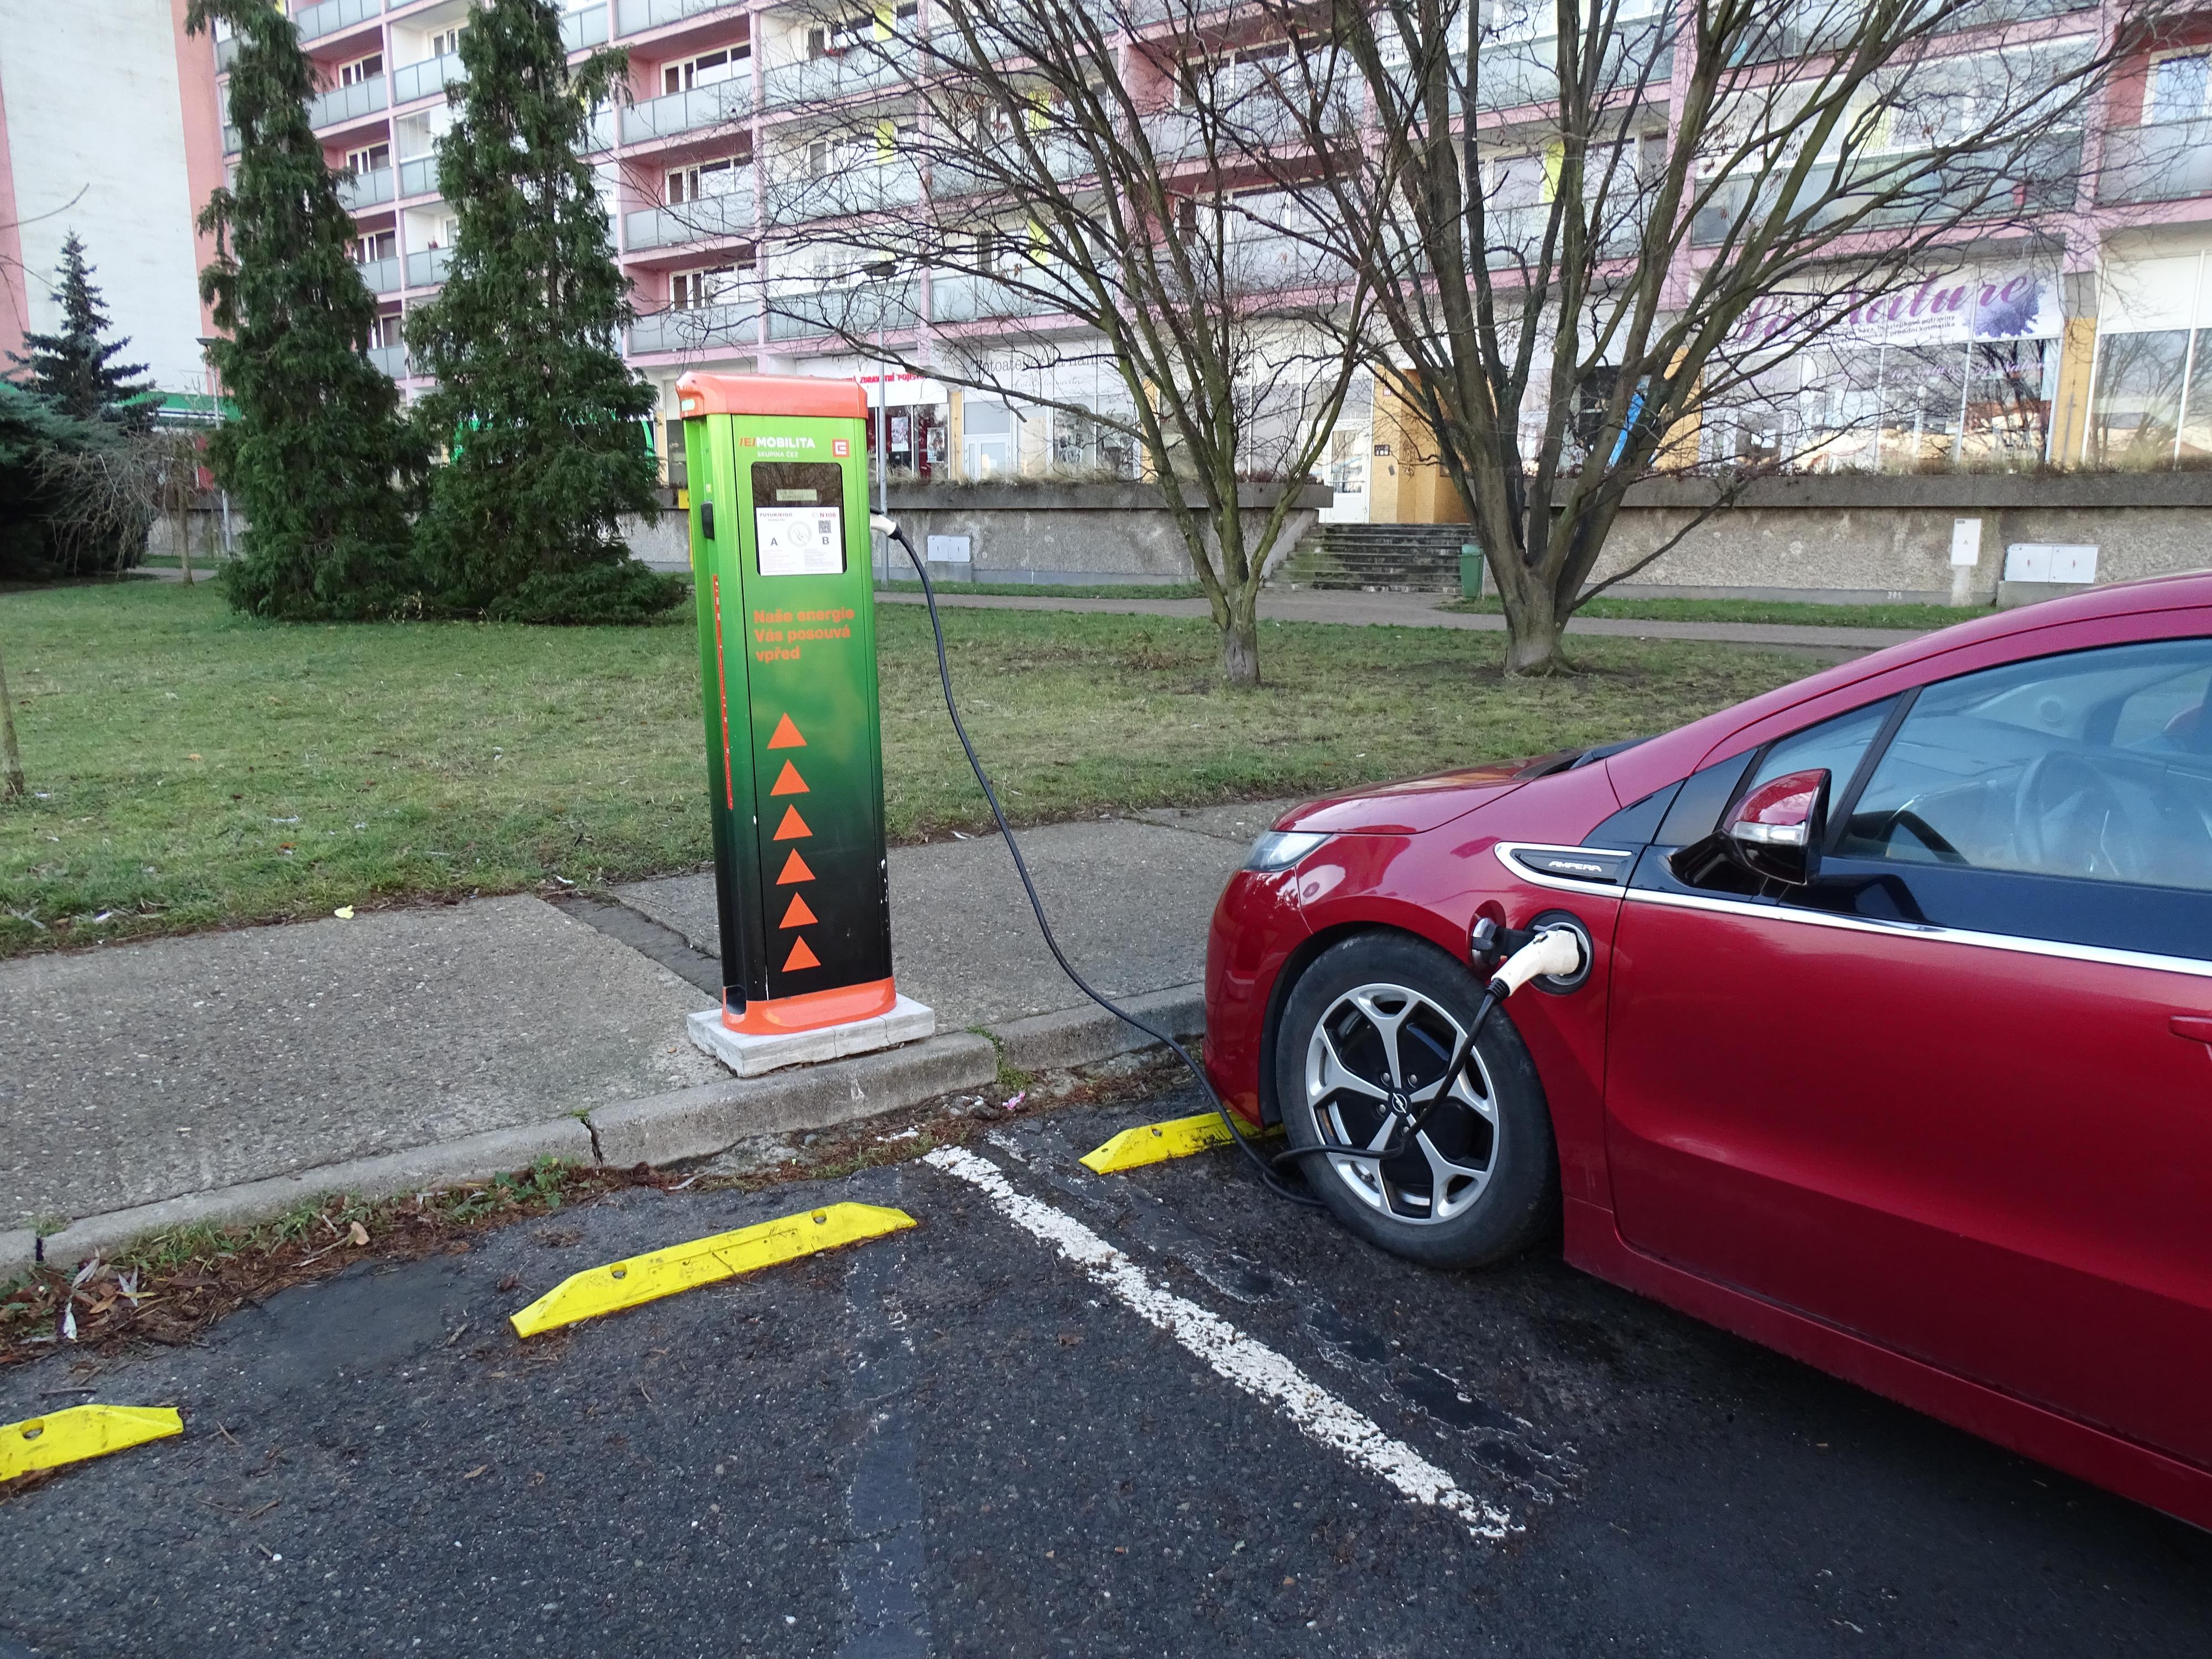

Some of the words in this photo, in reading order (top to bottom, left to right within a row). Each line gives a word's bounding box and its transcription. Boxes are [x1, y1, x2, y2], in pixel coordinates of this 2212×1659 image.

[1918, 322, 1955, 332] kosmetika
[859, 372, 895, 384] ZDRAVTNÍ
[786, 450, 799, 458] ČEZ
[770, 538, 778, 546] A
[822, 536, 830, 545] B
[753, 608, 793, 623] Naše
[796, 606, 855, 623] energie
[754, 628, 784, 643] Vás
[787, 624, 851, 644] posouvá
[755, 645, 801, 664] vpřed
[1548, 860, 1602, 872] AMPERA
